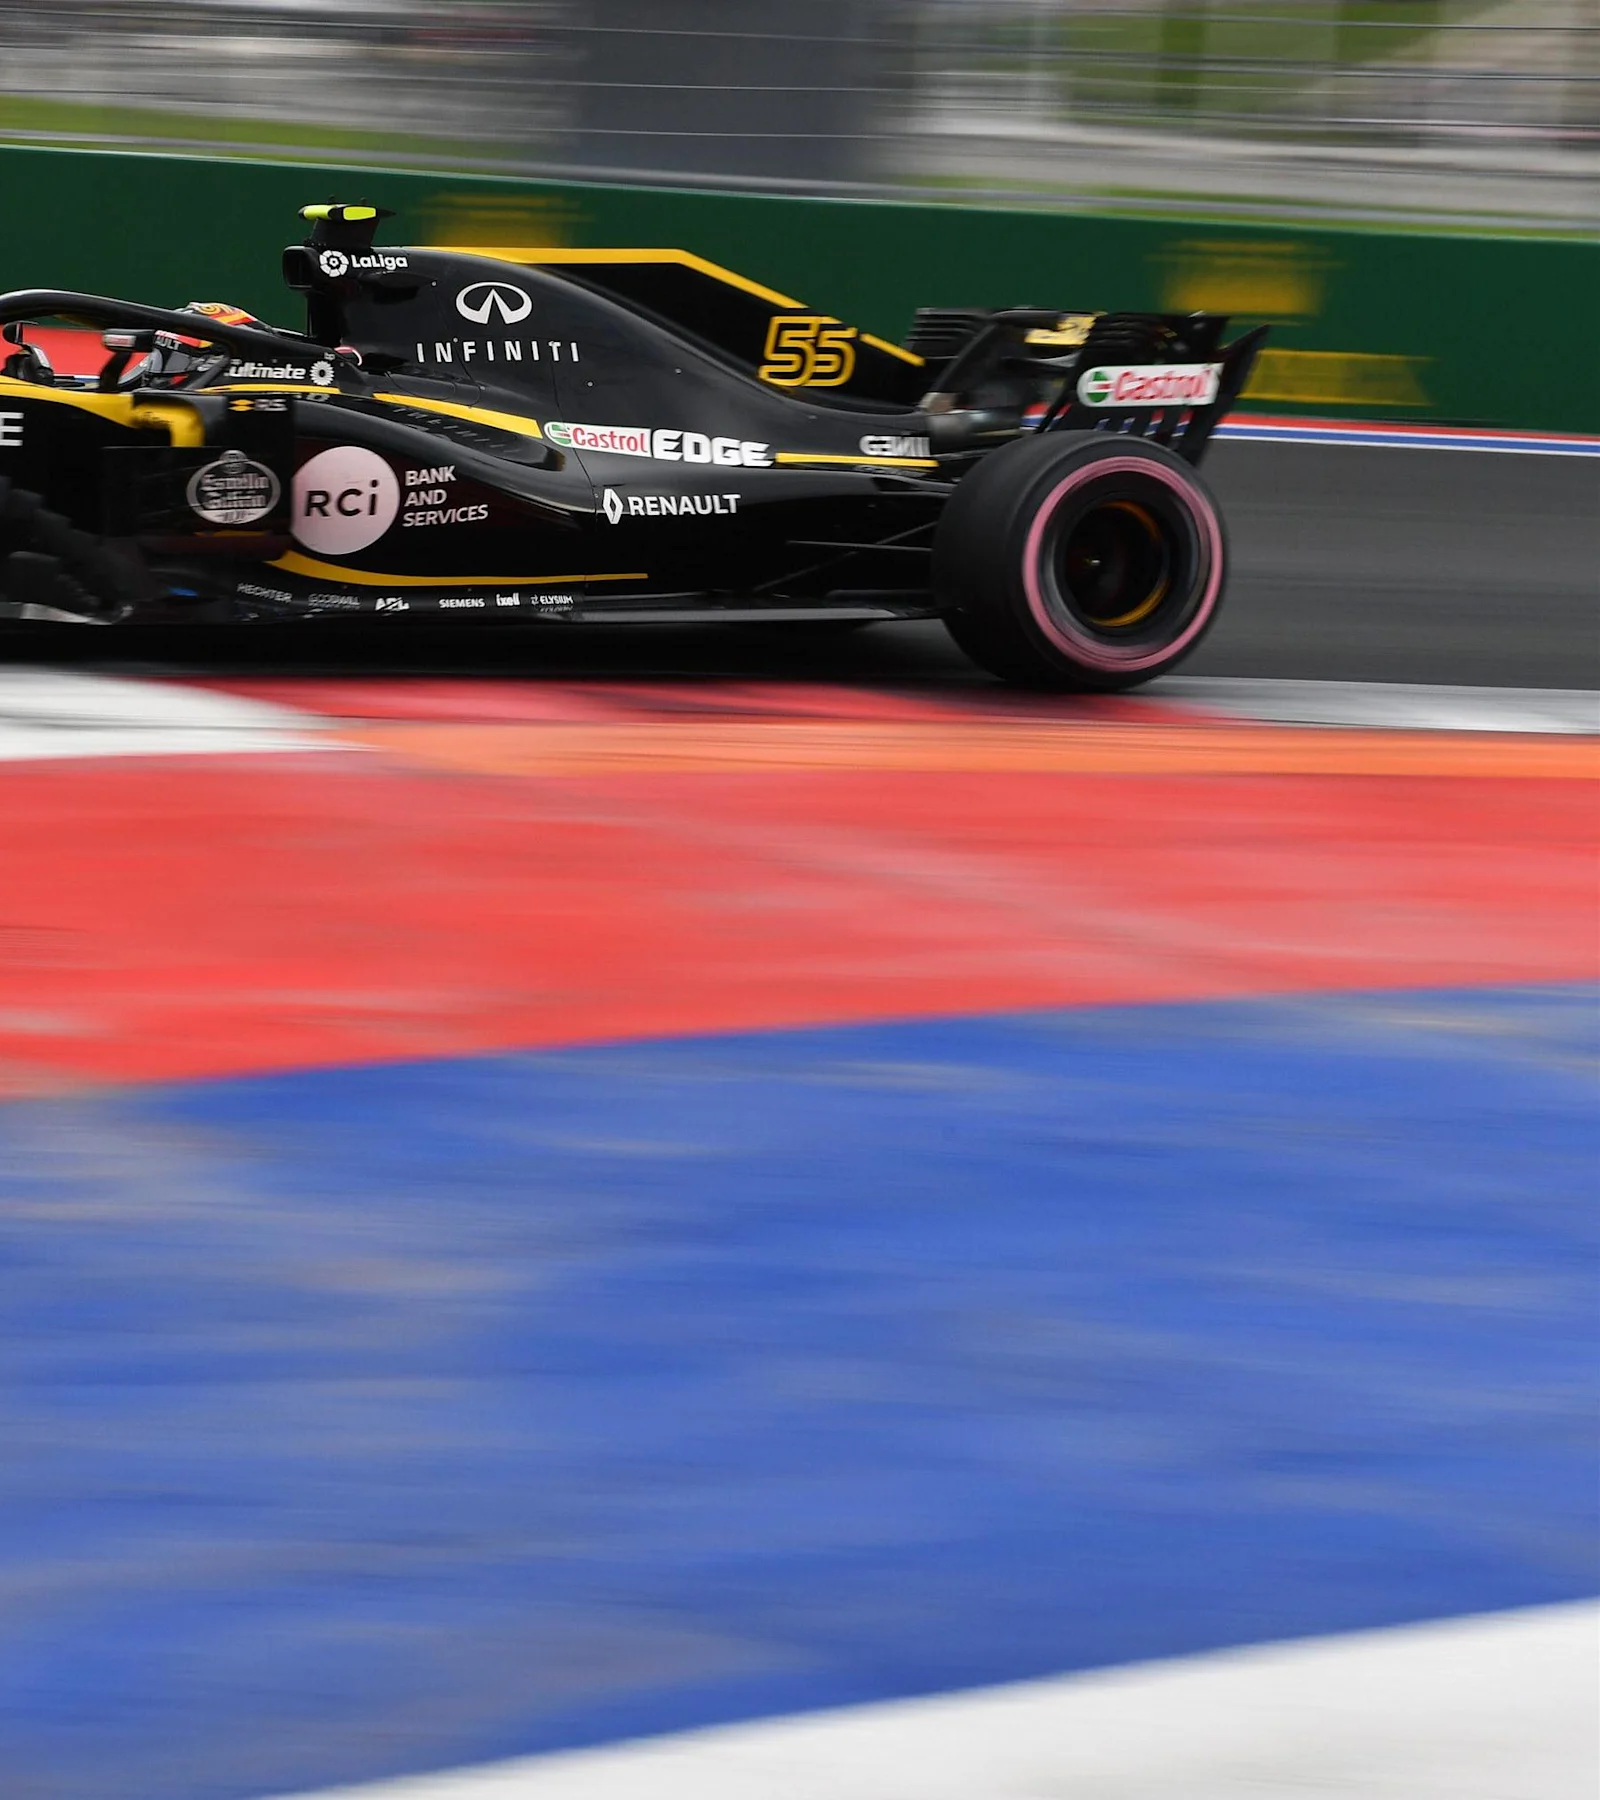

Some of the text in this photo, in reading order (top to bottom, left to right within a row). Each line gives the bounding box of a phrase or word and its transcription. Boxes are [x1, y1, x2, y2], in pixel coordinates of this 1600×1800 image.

[351, 254, 408, 271] LaLiga
[416, 340, 580, 363] INFINITI
[758, 316, 858, 387] 55
[1115, 370, 1212, 400] Castrol
[572, 427, 775, 467] Castrol EDGE
[404, 465, 457, 487] BANK
[304, 479, 379, 517] RCi
[404, 488, 448, 507] AND
[628, 494, 741, 516] RENAULT
[402, 504, 489, 527] SERVICES
[438, 599, 485, 609] SIEMENS
[539, 594, 574, 605] ELYSIUM
